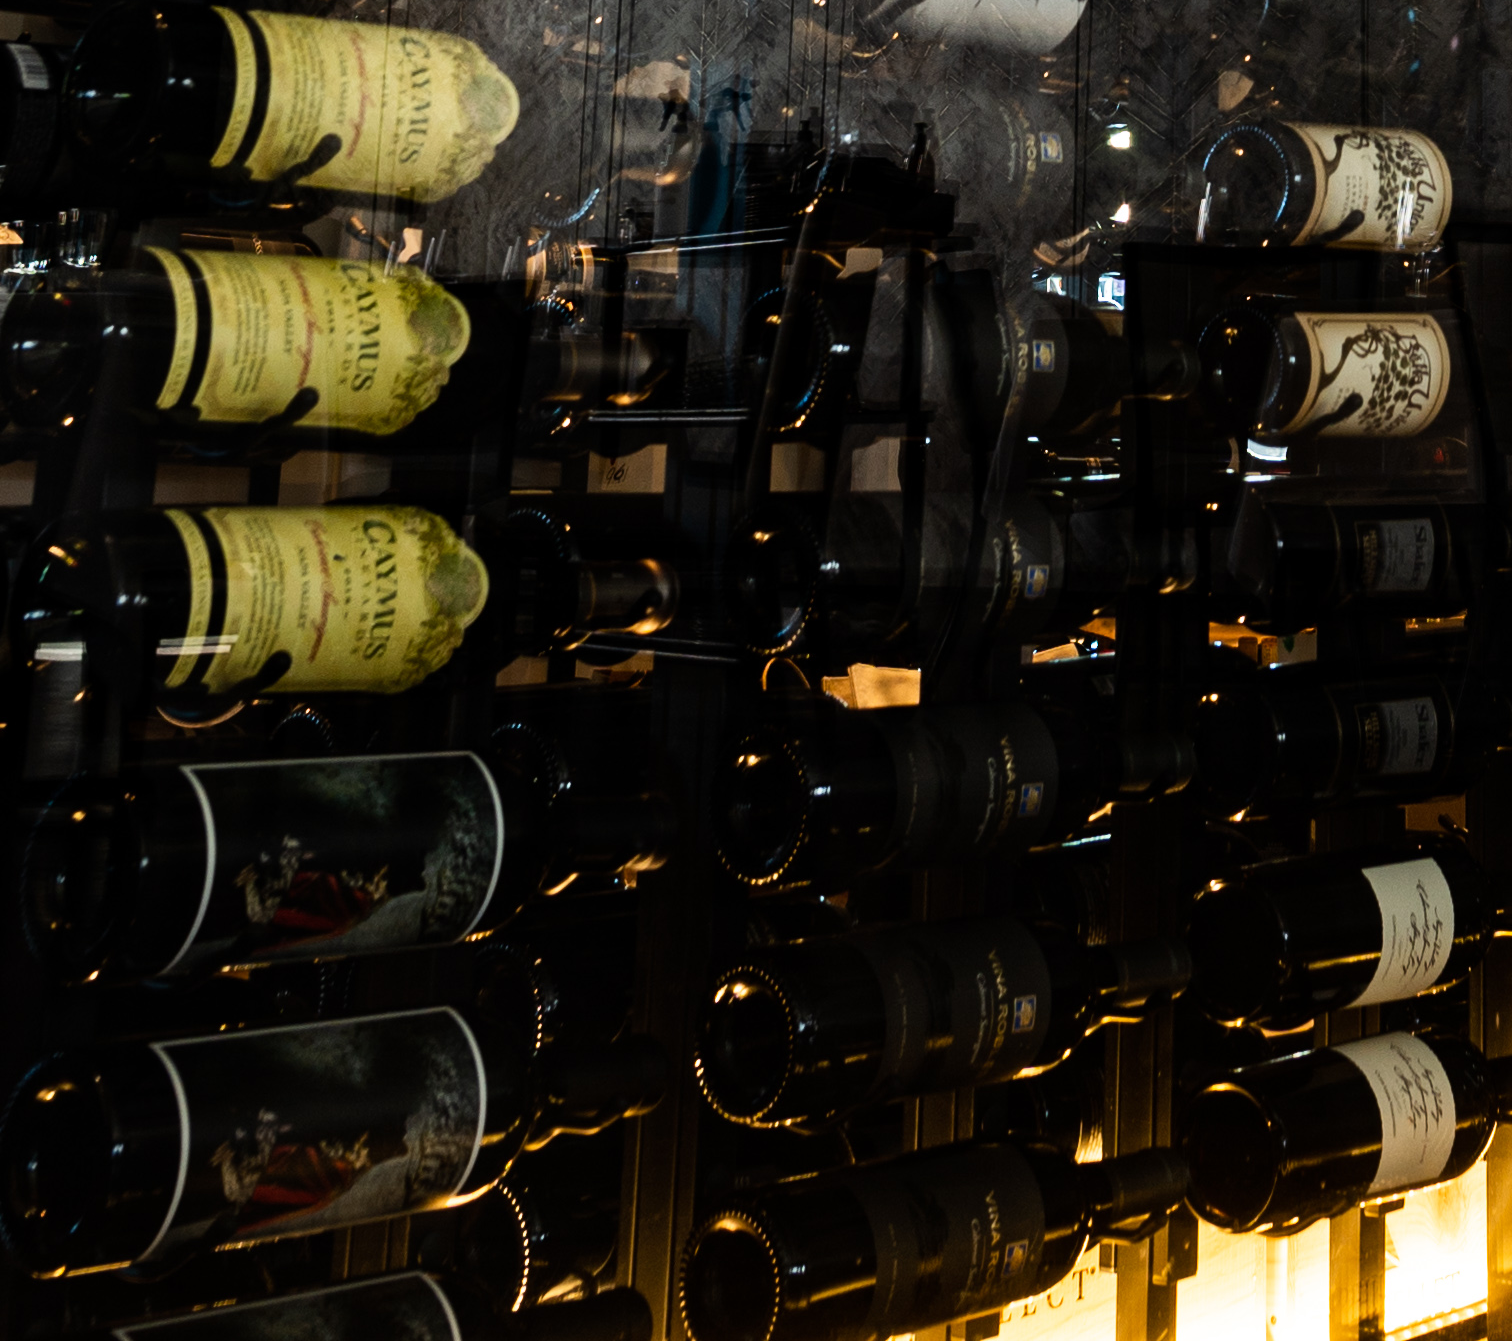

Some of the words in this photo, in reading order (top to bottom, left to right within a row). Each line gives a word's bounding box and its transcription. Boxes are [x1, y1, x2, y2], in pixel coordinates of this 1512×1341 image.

[398, 36, 431, 164] CAYMUS
[340, 263, 381, 393] CAYMUS
[1004, 518, 1023, 566] VINA
[362, 519, 399, 661] CAYMUS
[999, 734, 1016, 786] VINA
[988, 948, 1009, 1000] VINA
[985, 1189, 1002, 1244] VINA
